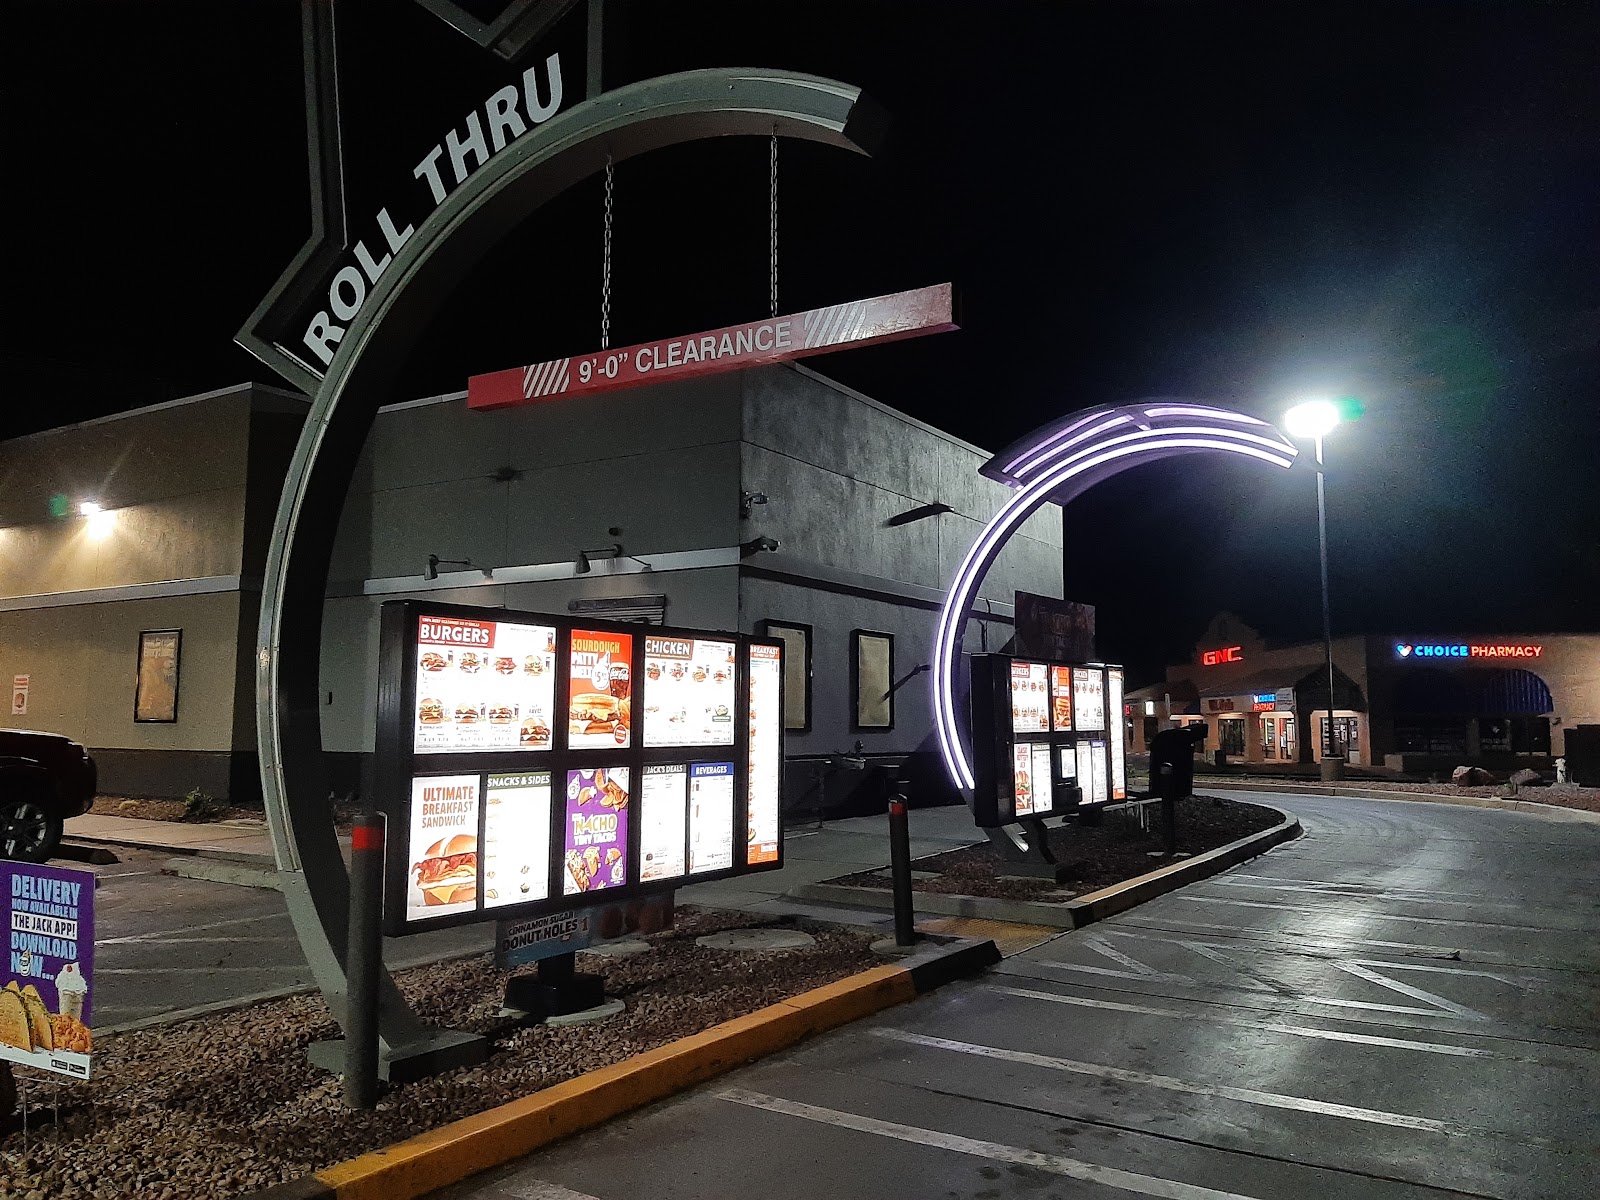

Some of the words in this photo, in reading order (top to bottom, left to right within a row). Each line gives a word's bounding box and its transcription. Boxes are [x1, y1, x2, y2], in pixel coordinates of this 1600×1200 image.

[303, 207, 415, 366] ROLL
[413, 52, 563, 206] THRU
[635, 321, 792, 373] CLEARANCE
[420, 624, 490, 643] BURGERS
[572, 638, 620, 654] SOURDOUGH
[645, 639, 691, 656] CHICKEN
[1415, 645, 1469, 657] CHOICE
[1471, 646, 1542, 657] PHARMACY
[1203, 646, 1243, 666] GNC
[646, 765, 666, 774] JACK'S
[666, 764, 683, 773] DEALS
[695, 766, 728, 775] BEVERAGES
[487, 776, 520, 788] SNACKS
[520, 776, 527, 785] &
[528, 774, 551, 785] SIDES
[423, 785, 474, 802] ULTIMATE
[422, 801, 474, 816] BREAKFAST
[421, 815, 466, 829] SANDWICH
[574, 813, 617, 834] NACHO
[11, 873, 81, 906] DELIVERY
[11, 897, 30, 911] NOW
[30, 899, 69, 917] AVAILABLE
[69, 906, 78, 919] IN
[14, 913, 30, 928] THE
[32, 915, 53, 934] JACK
[54, 921, 76, 937] APP!
[508, 917, 549, 935] CINNAMON
[549, 911, 575, 924] SUGAR
[502, 930, 541, 952] DONUT
[543, 918, 578, 939] HOLES
[11, 931, 77, 960] DOWNLOAD
